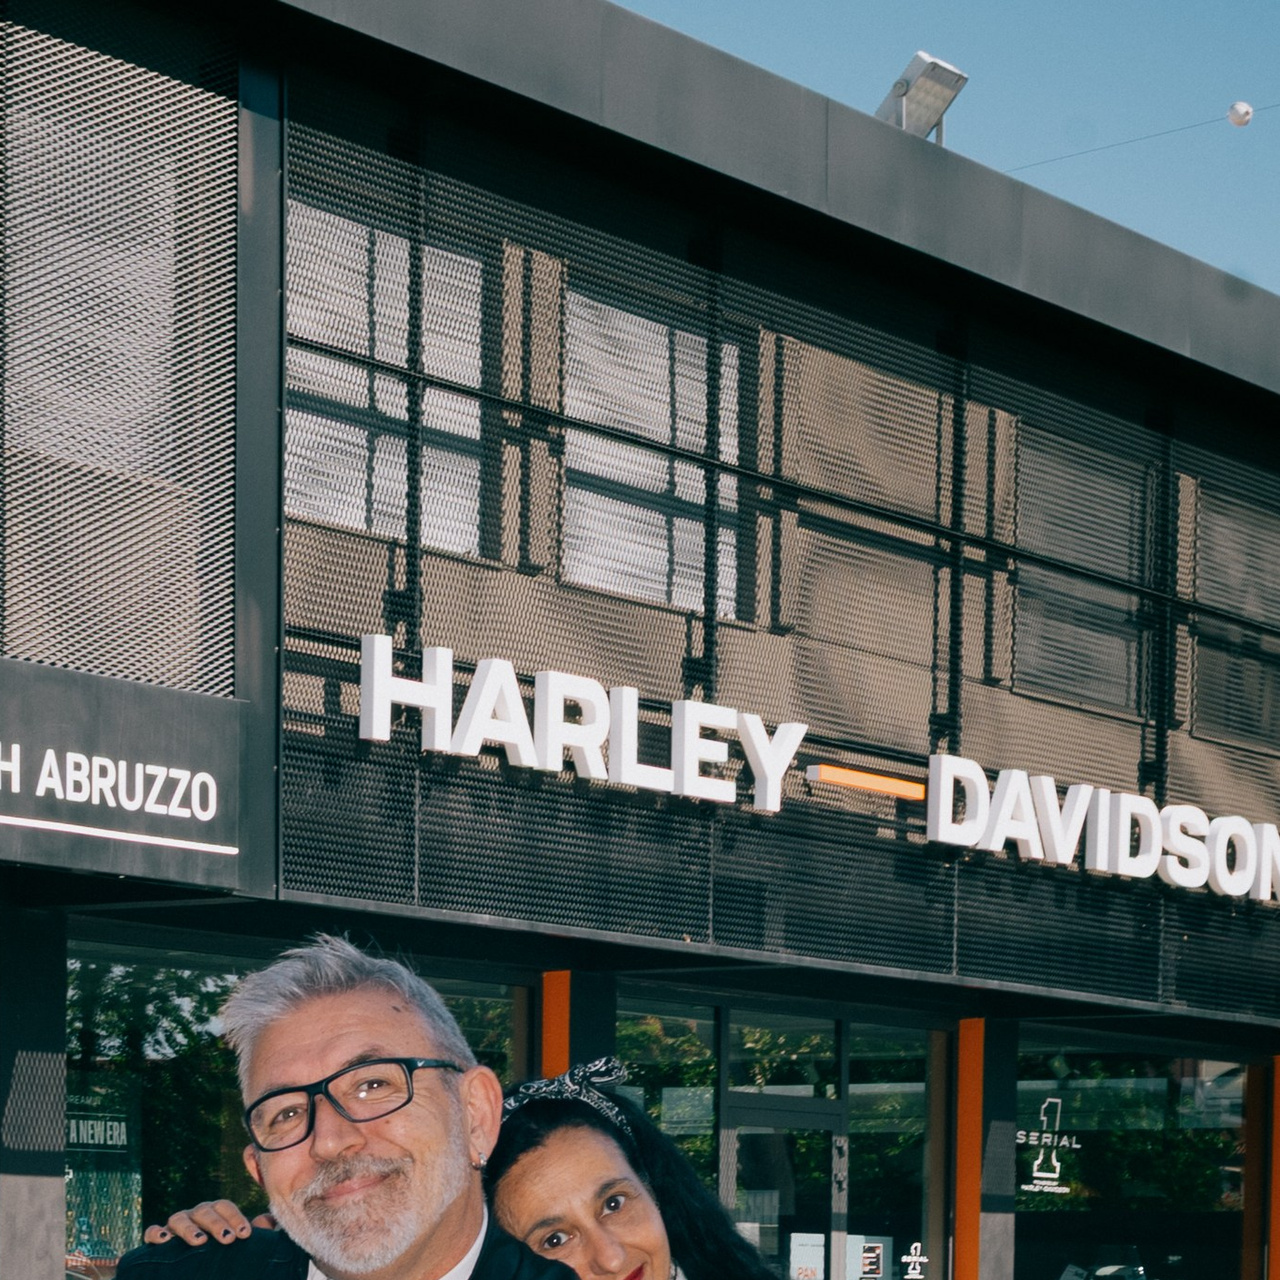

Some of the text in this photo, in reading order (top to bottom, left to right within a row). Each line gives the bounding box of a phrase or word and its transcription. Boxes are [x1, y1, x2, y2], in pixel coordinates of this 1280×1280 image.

[359, 633, 809, 813] HARLEY
[34, 748, 218, 822] ABRUZZO
[69, 1119, 128, 1146] A NEW ERA
[1016, 1130, 1082, 1149] SERIAL
